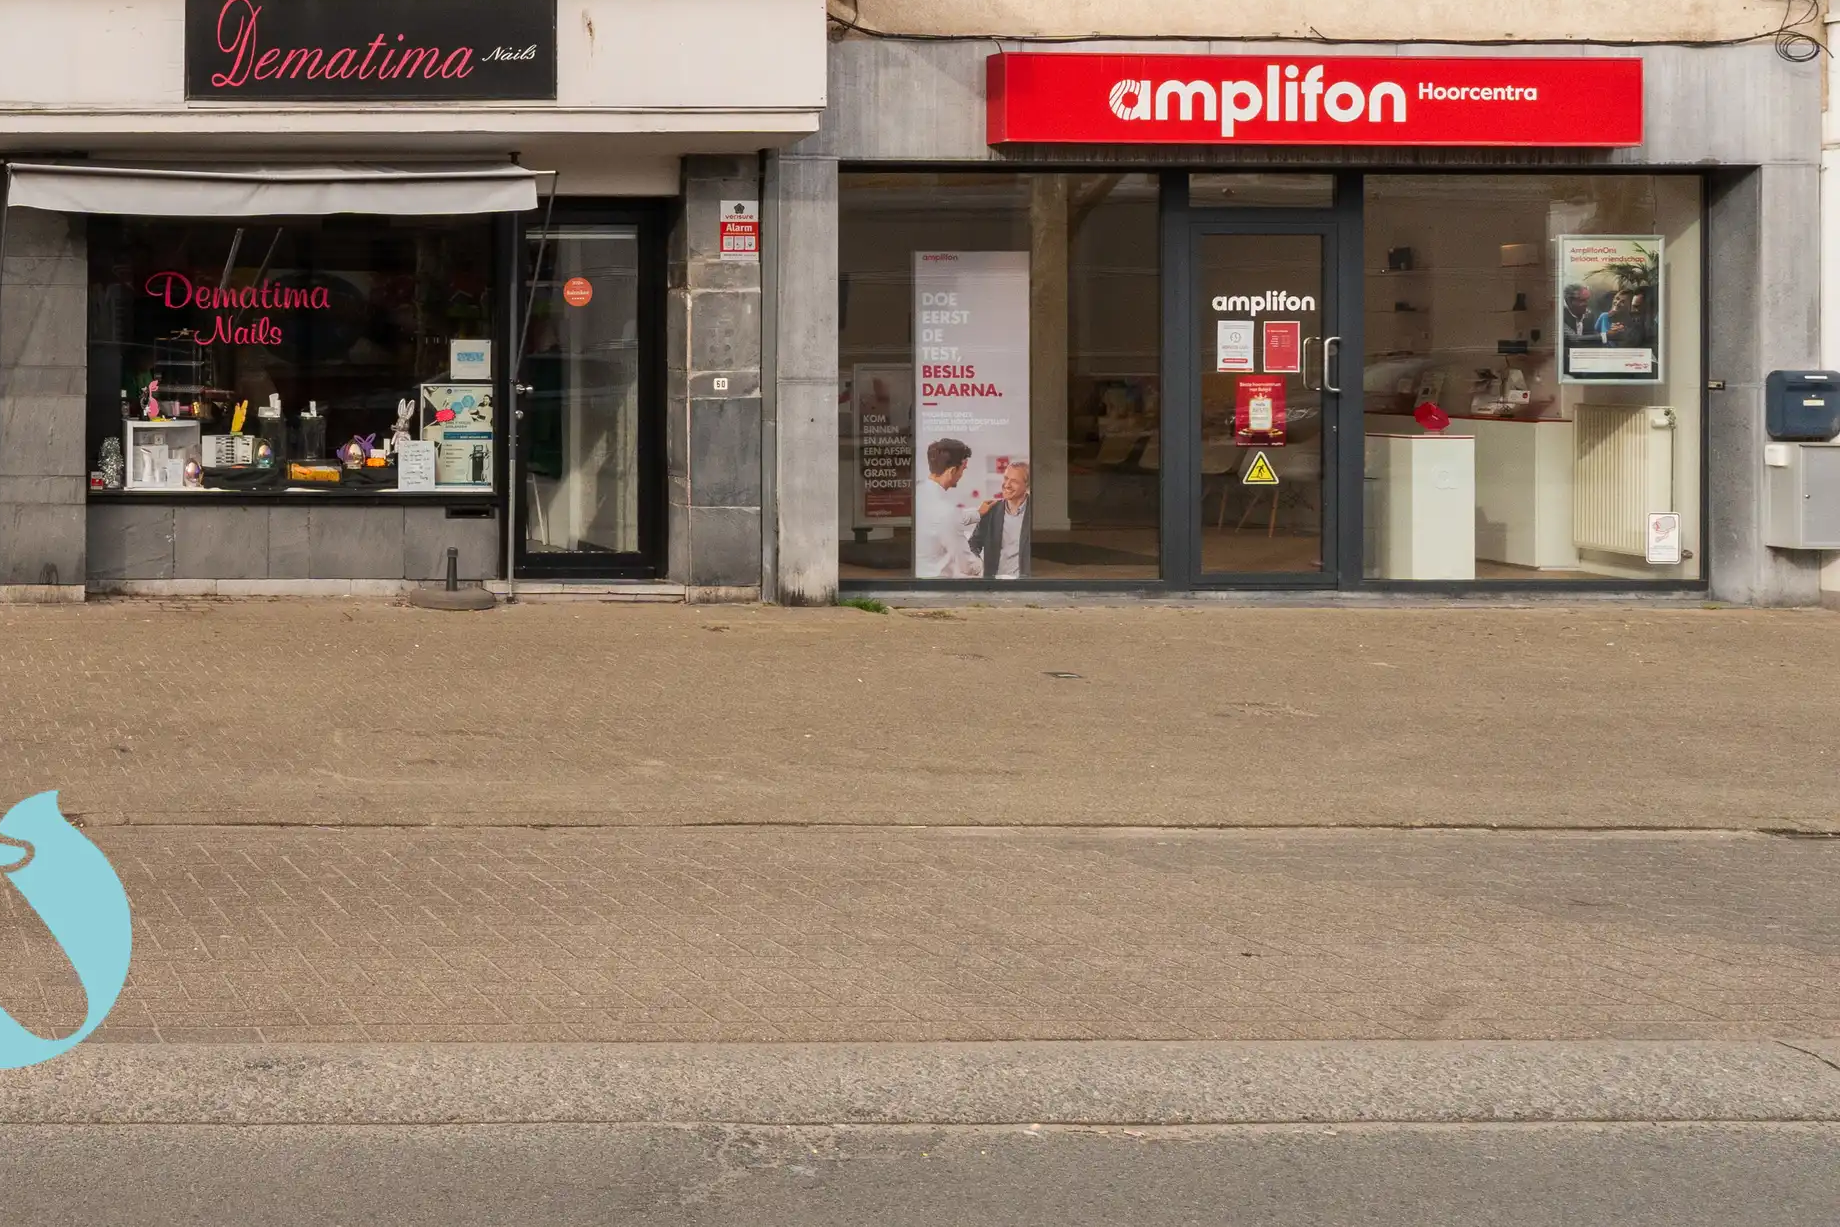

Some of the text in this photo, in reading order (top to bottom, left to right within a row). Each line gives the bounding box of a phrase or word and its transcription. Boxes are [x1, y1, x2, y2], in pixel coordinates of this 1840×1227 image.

[481, 43, 538, 63] Nails
[1108, 64, 1539, 138] amplifon Hoorcentra
[726, 223, 753, 232] Alarm
[1570, 246, 1617, 255] AmplifonOns
[922, 253, 959, 263] amplifon
[1570, 255, 1599, 263] beloont
[145, 271, 331, 310] Dematima
[922, 292, 958, 306] DOE
[1212, 290, 1316, 317] amplifon
[922, 310, 970, 324] EERST
[194, 315, 283, 346] Nails
[922, 328, 943, 342] DE
[922, 347, 962, 363] TEST,
[922, 365, 976, 379] BESLIS
[716, 380, 726, 388] 60
[922, 383, 1003, 397] DAARNA.
[863, 414, 886, 423] KOM
[863, 425, 899, 434] BINNEN
[863, 436, 907, 445] EN MAAK
[864, 447, 911, 456] EEN AFSPR
[864, 458, 911, 467] VOOR UW
[864, 468, 897, 478] GRATIS
[864, 479, 912, 489] HOORTEST
